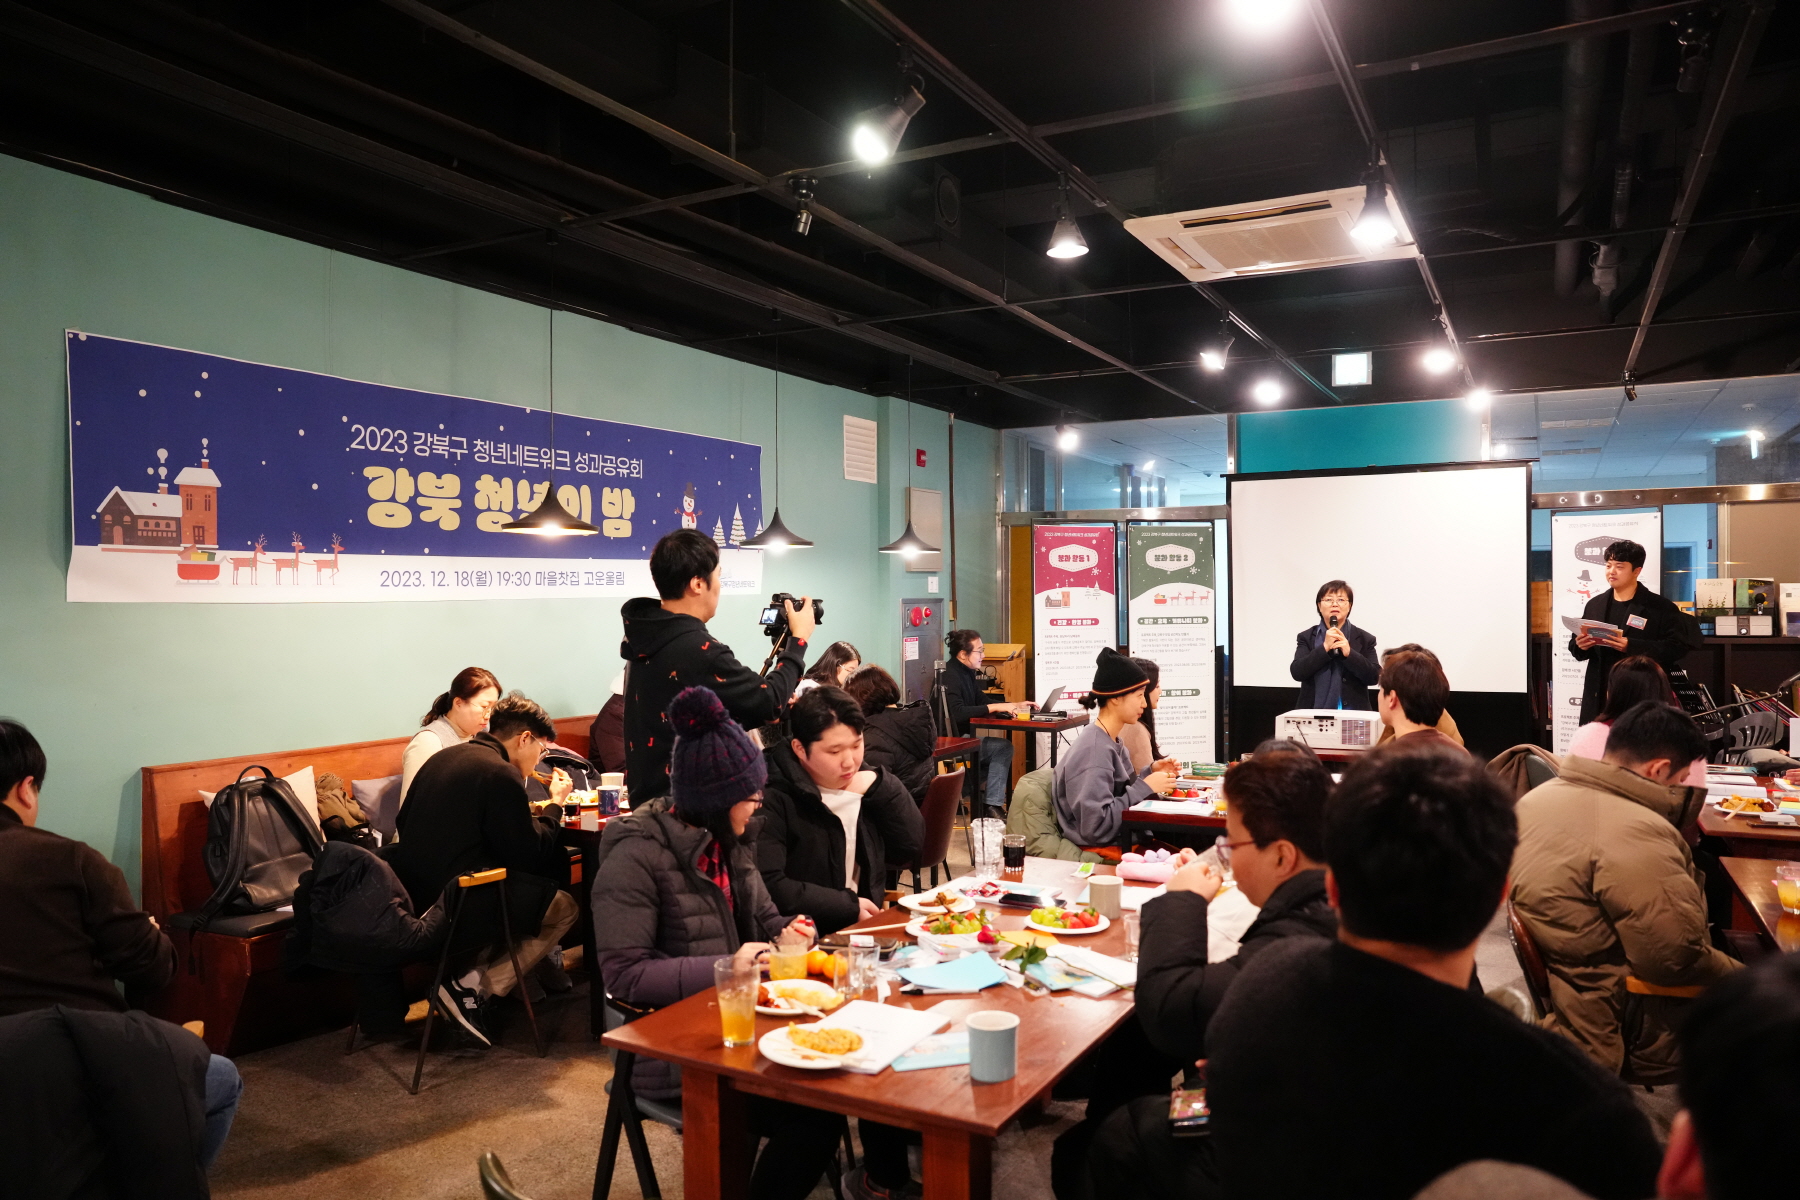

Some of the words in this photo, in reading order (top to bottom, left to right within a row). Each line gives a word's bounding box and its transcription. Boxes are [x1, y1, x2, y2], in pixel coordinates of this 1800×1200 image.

[350, 424, 408, 454] 2023
[413, 431, 468, 461] 강북구
[473, 439, 571, 472] 청년네트워크
[574, 453, 643, 479] 성과공유회
[362, 465, 462, 531] 강북
[602, 486, 635, 538] 밤
[380, 570, 426, 588] 2023.
[431, 571, 450, 587] 12.
[454, 570, 493, 588] 18(월)
[497, 570, 532, 587] 19:30
[535, 570, 581, 587] 마을찻집
[584, 570, 625, 587] 고운울림
[462, 996, 478, 1010] N
